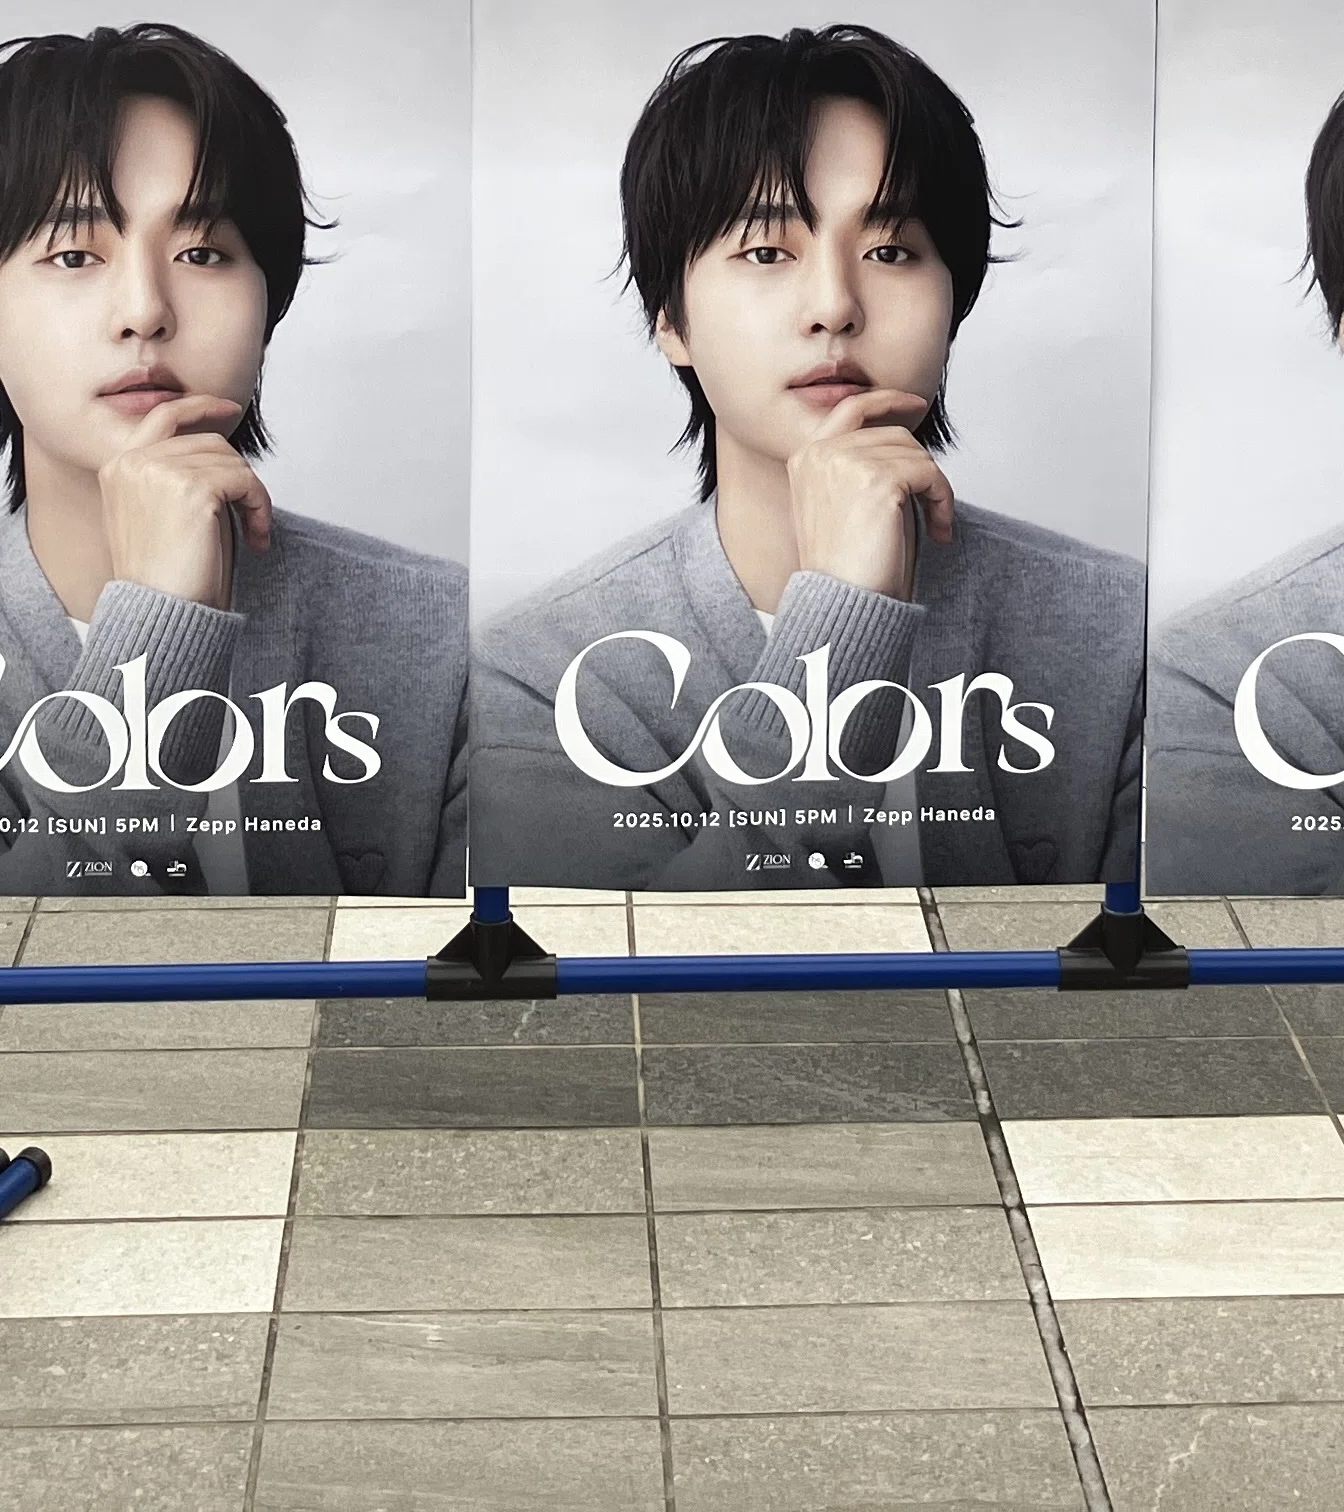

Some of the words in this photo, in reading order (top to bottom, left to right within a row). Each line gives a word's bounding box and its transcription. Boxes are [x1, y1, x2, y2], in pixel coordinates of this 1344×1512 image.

[554, 629, 1056, 787] Colors
[48, 816, 106, 835] [SUN]
[116, 818, 159, 833] 5PM
[186, 817, 237, 836] Zepp
[244, 817, 321, 832] Haneda
[613, 811, 720, 828] 2025.10.12
[729, 808, 786, 828] [SUN]
[795, 808, 837, 824] 5PM
[863, 808, 913, 826] Zepp
[920, 806, 995, 822] Haneda
[84, 861, 113, 872] ZION
[763, 854, 791, 865] ZION
